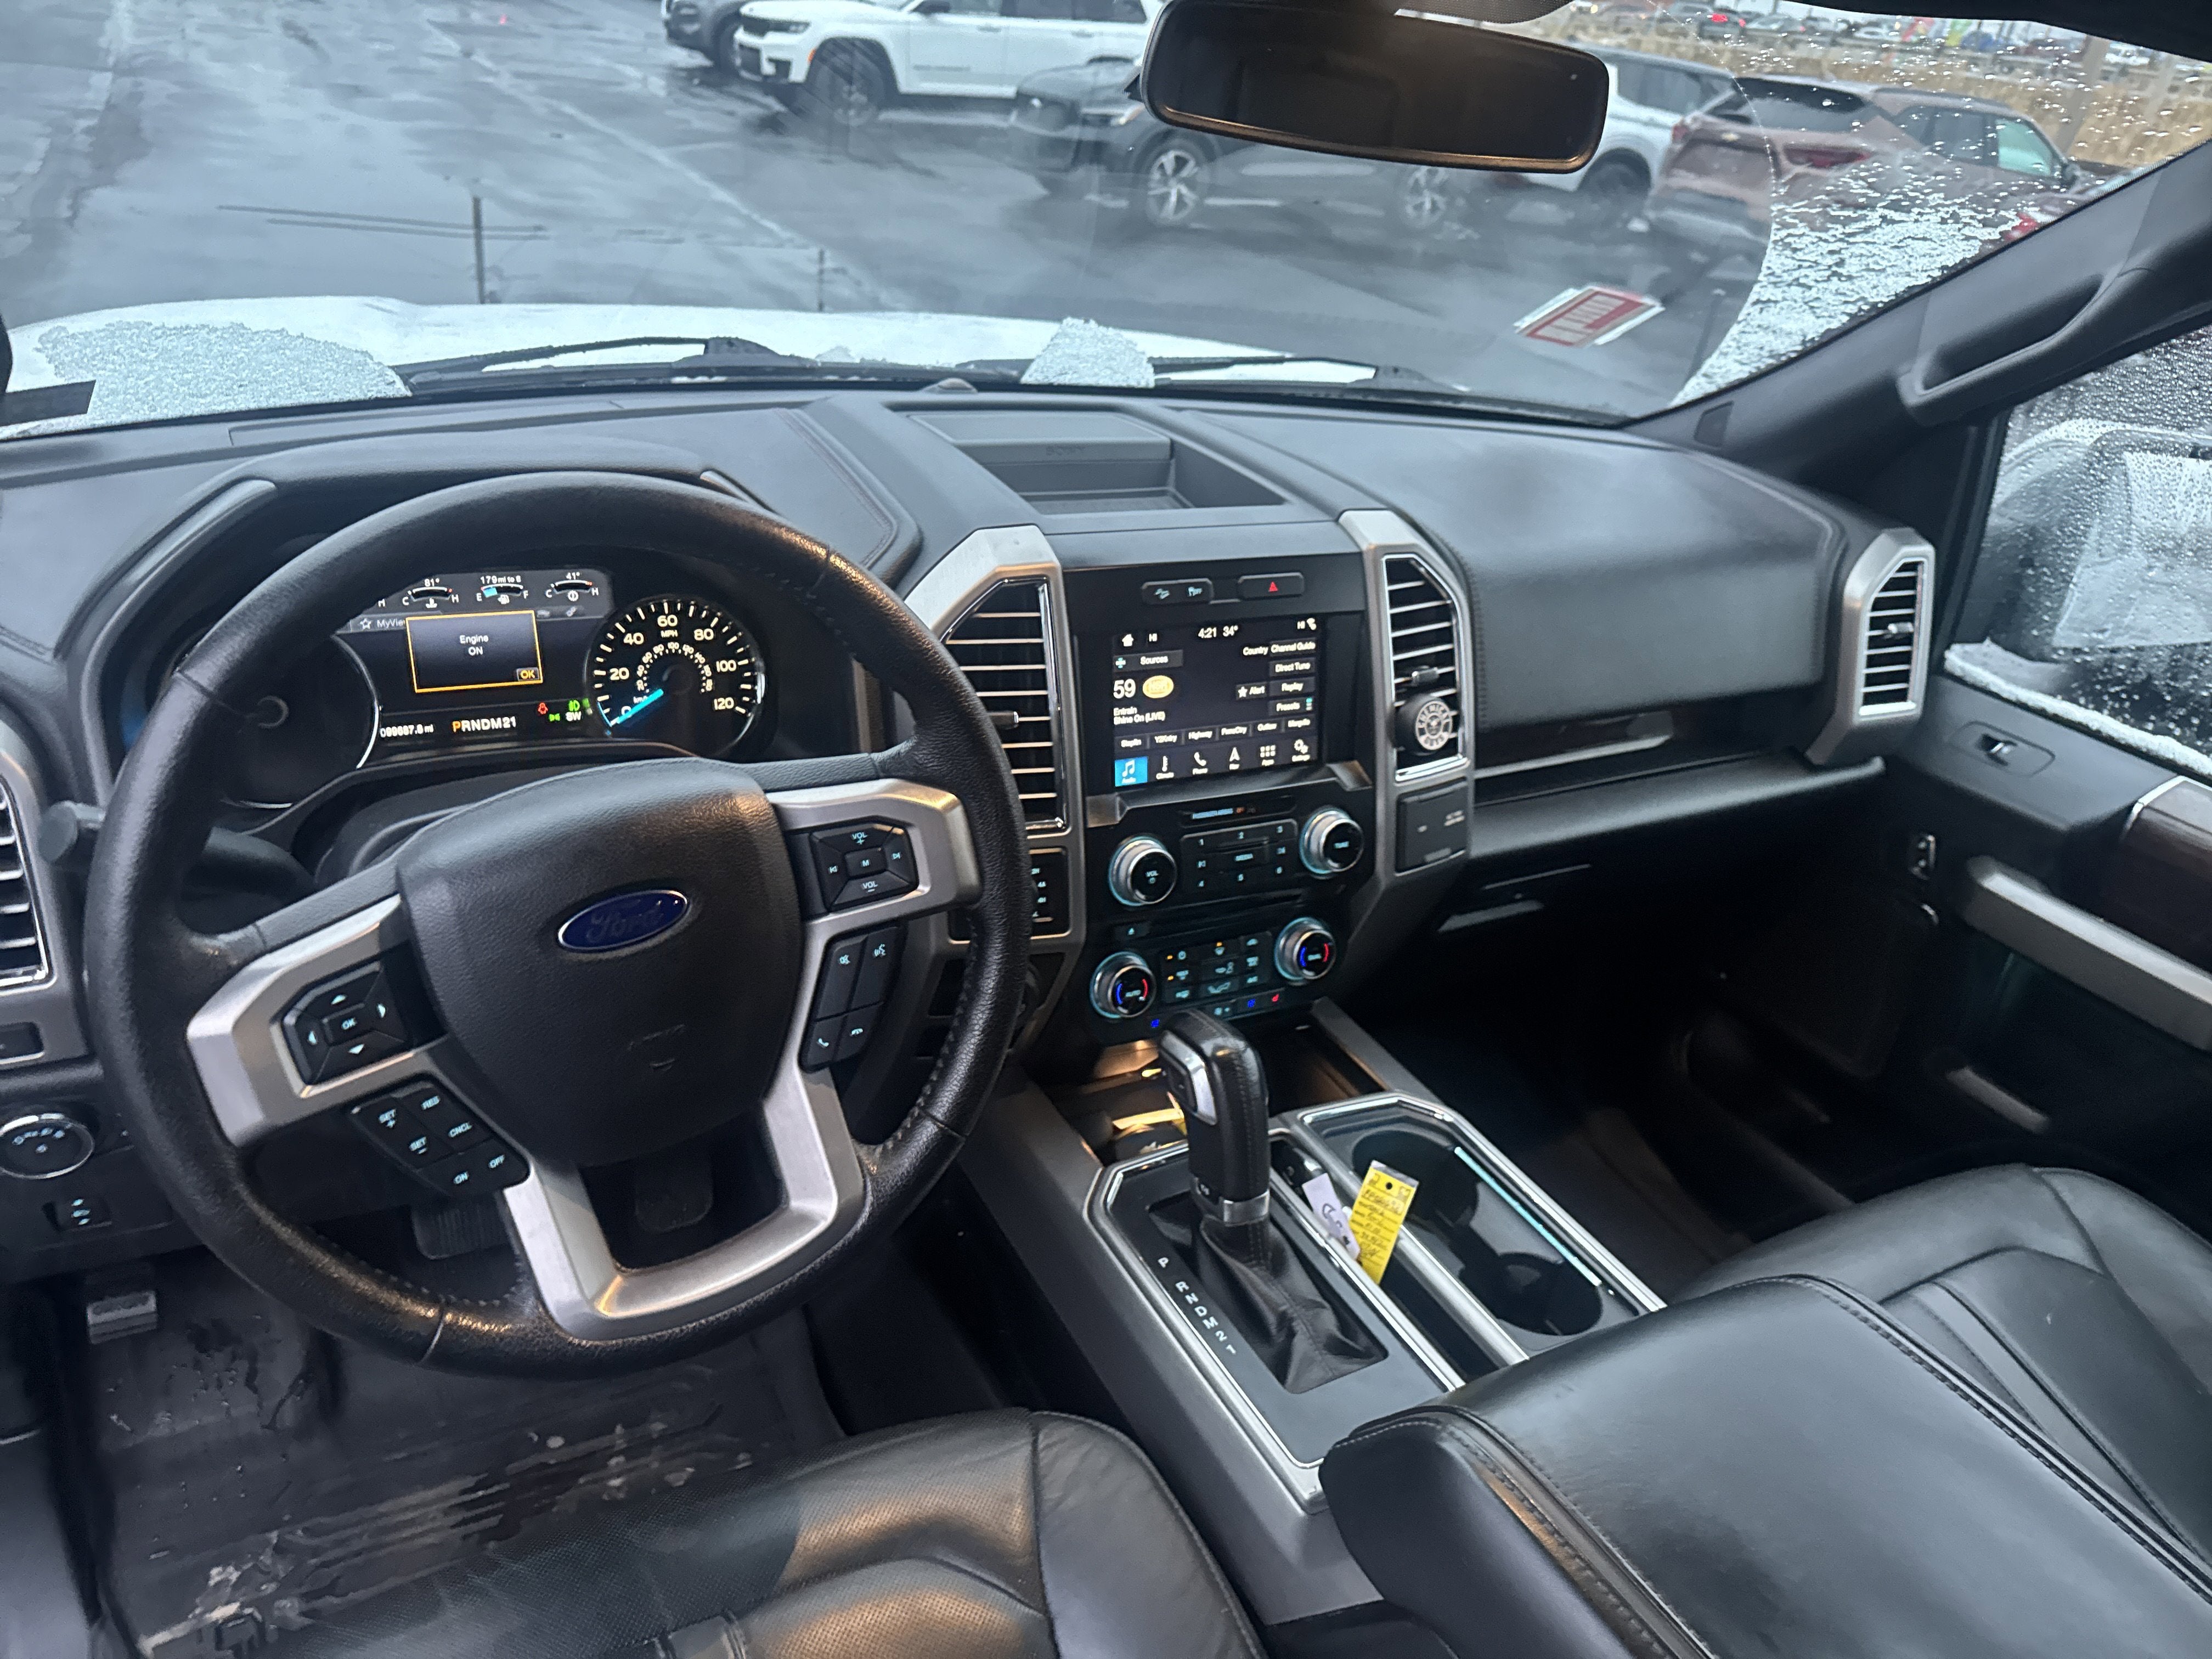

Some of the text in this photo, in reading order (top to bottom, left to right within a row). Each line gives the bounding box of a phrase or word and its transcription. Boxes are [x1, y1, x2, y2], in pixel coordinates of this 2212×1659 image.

[476, 592, 482, 602] E
[657, 614, 678, 627] 60
[623, 632, 645, 645] 40
[694, 628, 714, 641] 80
[1198, 627, 1217, 639] 4:21
[459, 635, 489, 645] Engine
[468, 646, 483, 656] ON
[1243, 646, 1269, 656] Country
[1271, 641, 1316, 653] Channel Guide
[716, 659, 737, 672] 100
[1140, 656, 1169, 665] Sources
[610, 667, 629, 680] 20
[1275, 662, 1311, 673] Direct Tune
[521, 670, 535, 679] OK
[1113, 678, 1136, 699] 59
[714, 697, 734, 710] 120
[1133, 714, 1144, 724] On
[851, 832, 867, 840] VOL
[862, 881, 878, 889] VOL
[341, 1017, 356, 1030] OK
[448, 1121, 472, 1138] CNCL
[409, 1137, 426, 1152] SET
[453, 1171, 469, 1185] ON
[1158, 1256, 1236, 1355] P R N D M 2 1
